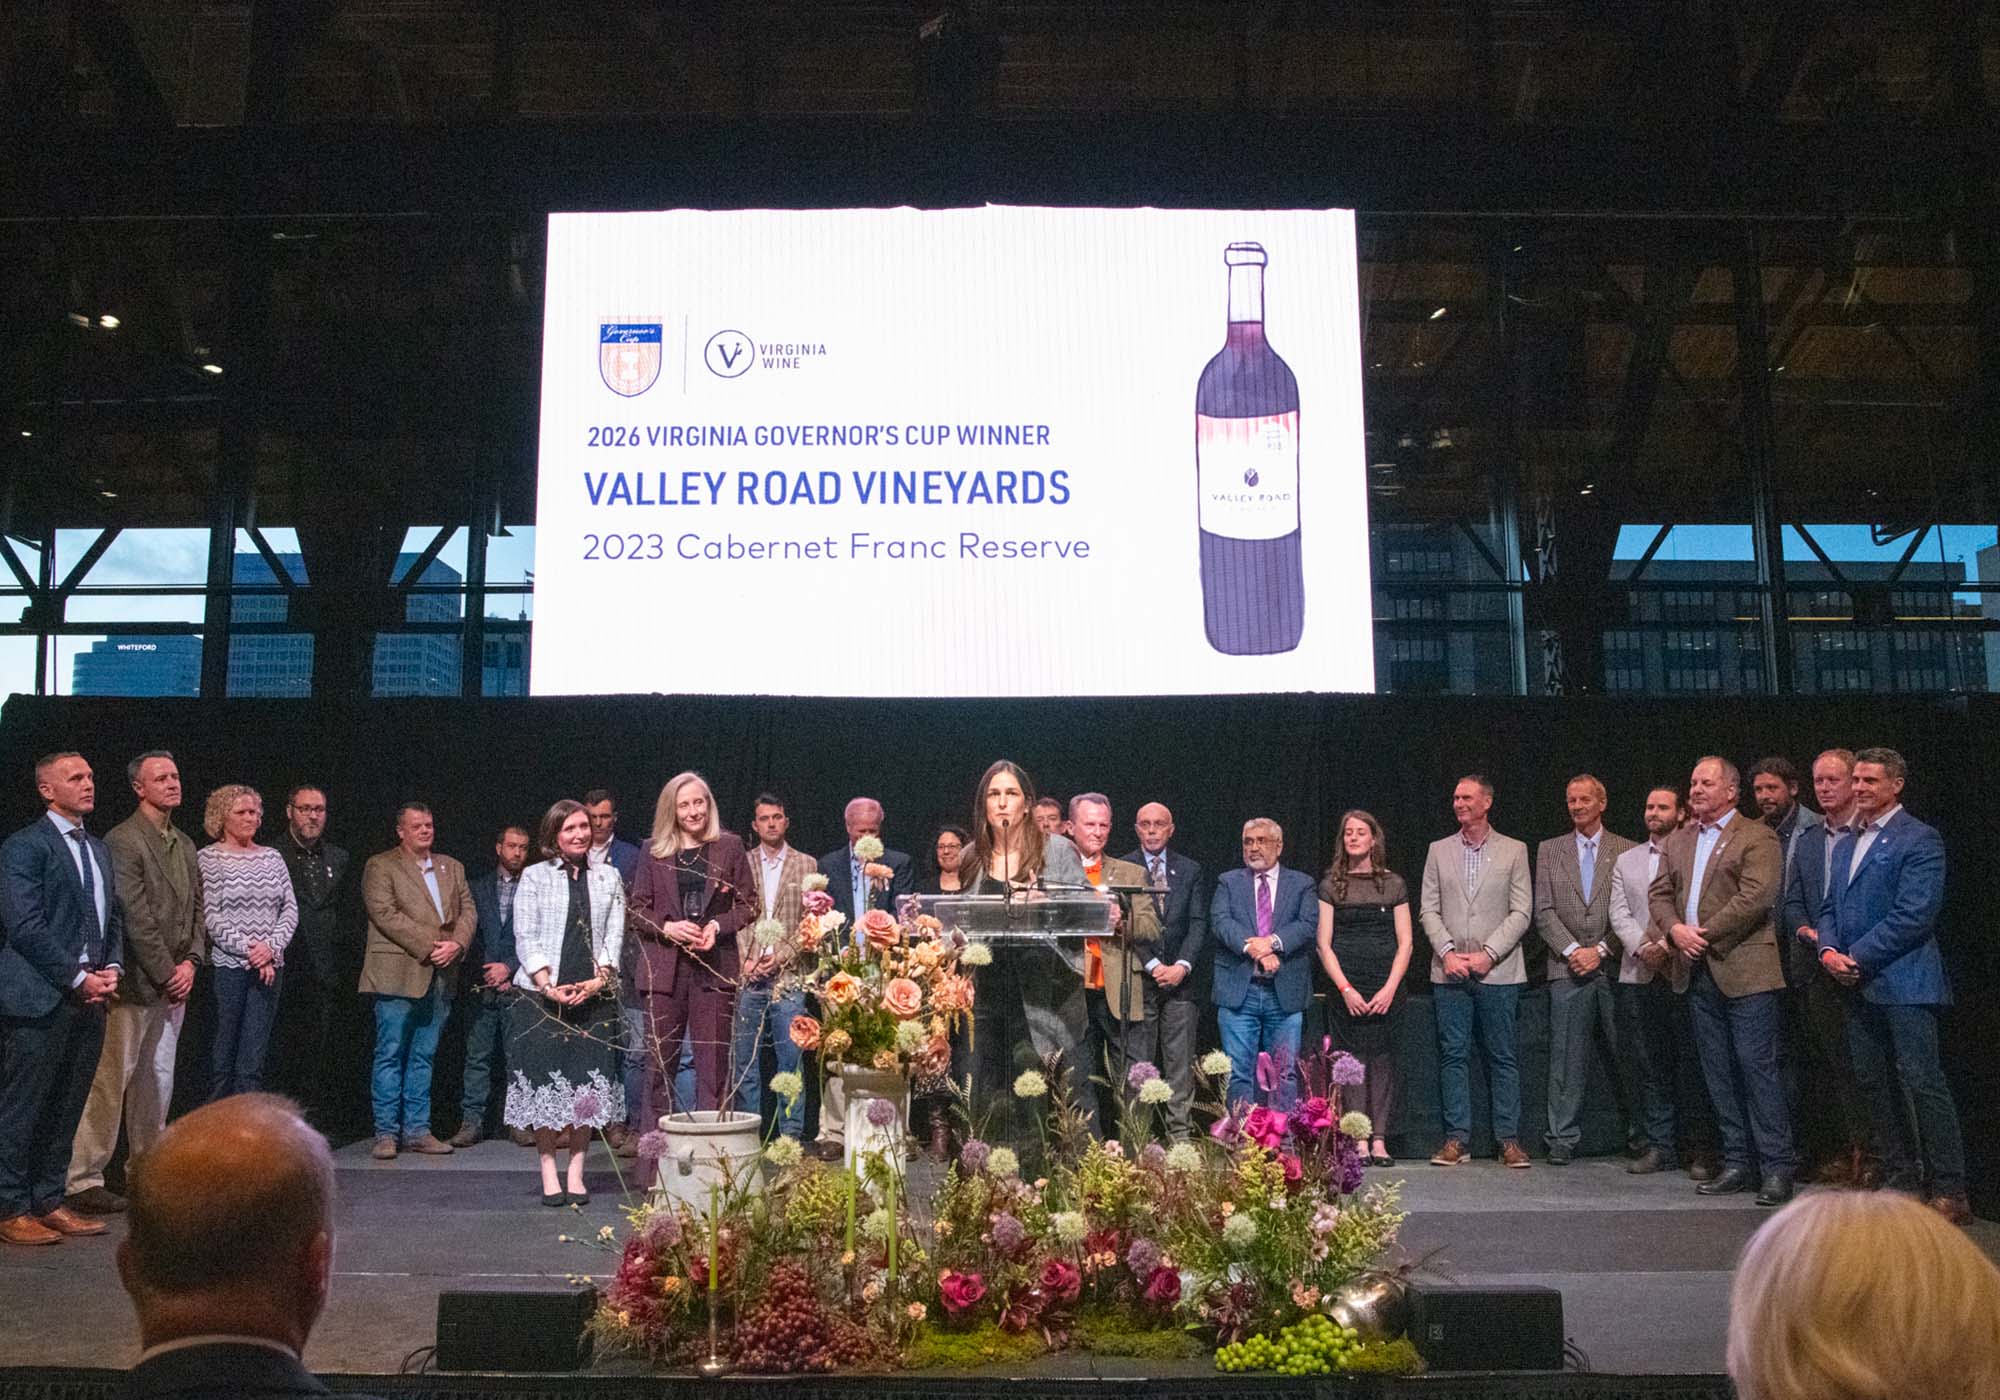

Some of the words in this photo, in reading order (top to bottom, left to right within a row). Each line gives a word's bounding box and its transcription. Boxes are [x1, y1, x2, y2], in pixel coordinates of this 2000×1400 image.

[603, 325, 656, 340] Governor's
[619, 334, 640, 344] Cup
[759, 343, 827, 356] VIRGINIA
[762, 357, 801, 369] WINE
[587, 426, 641, 447] 2026
[647, 425, 749, 447] VIRGINIA
[754, 425, 900, 447] GOVERNOR'S
[905, 424, 951, 446] CUP
[957, 424, 1050, 446] WINNER
[584, 471, 727, 506] VALLEY
[737, 470, 842, 505] ROAD
[852, 470, 1071, 505] VINEYARDS
[1211, 493, 1255, 503] VALLEY
[583, 533, 664, 561] 2023
[676, 532, 839, 560] Cabernet
[850, 532, 947, 560] Franc
[959, 531, 1091, 560] Reserve
[117, 643, 157, 651] WHITEFORD
